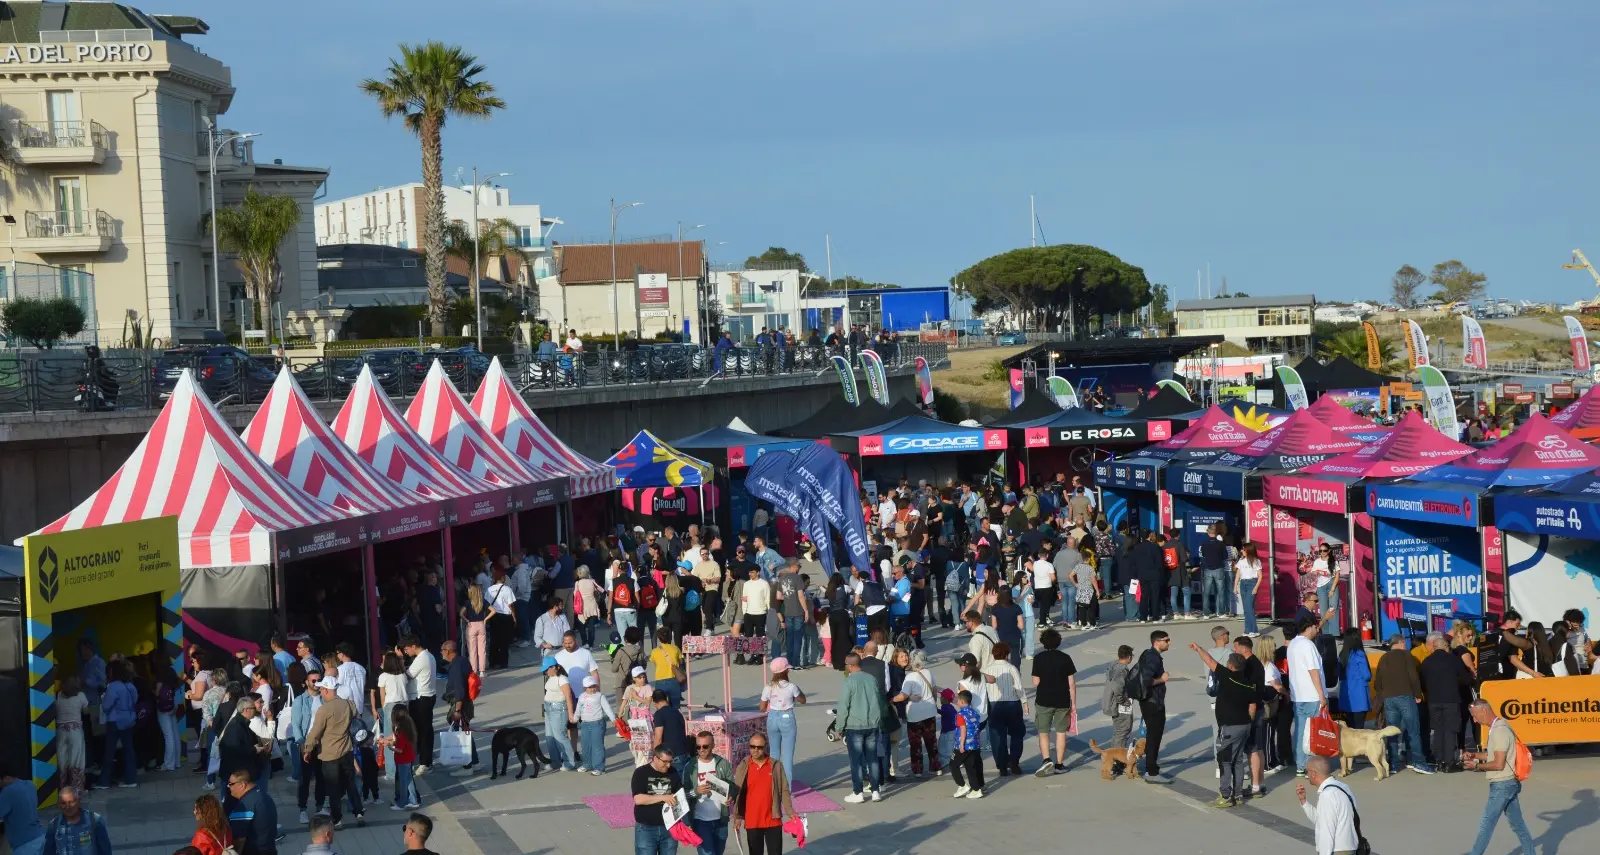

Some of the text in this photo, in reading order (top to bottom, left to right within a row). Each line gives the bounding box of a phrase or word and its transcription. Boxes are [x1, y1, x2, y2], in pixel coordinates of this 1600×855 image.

[26, 44, 70, 63] DEL
[76, 43, 151, 62] PORTO
[1061, 427, 1136, 440] DE ROSA
[1209, 431, 1247, 440] Giro d'Italia
[1279, 455, 1326, 463] Cetilar
[1534, 448, 1586, 460] Giro d'Italia
[1096, 466, 1107, 476] sara
[1115, 468, 1126, 478] sara
[1135, 469, 1146, 480] sara
[1183, 471, 1203, 484] Cetilar
[1279, 483, 1339, 506] CITTÀ DI TAPPA
[653, 497, 686, 512] GIROLAND
[1377, 497, 1395, 509] CARTA
[1395, 499, 1424, 513] D'IDENTITÀ
[1536, 507, 1565, 517] autostrade
[1536, 516, 1565, 528] per l'Italia
[302, 543, 317, 553] MUSEO
[317, 542, 325, 550] DEL
[325, 540, 335, 549] GIRO
[335, 536, 351, 546] D'ITALIA
[1386, 549, 1452, 576] SE NON È
[69, 574, 87, 585] cuore
[87, 571, 97, 581] del
[97, 568, 115, 583] grano
[1527, 717, 1541, 725] The
[1542, 716, 1569, 725] Future
[1570, 715, 1578, 723] in
